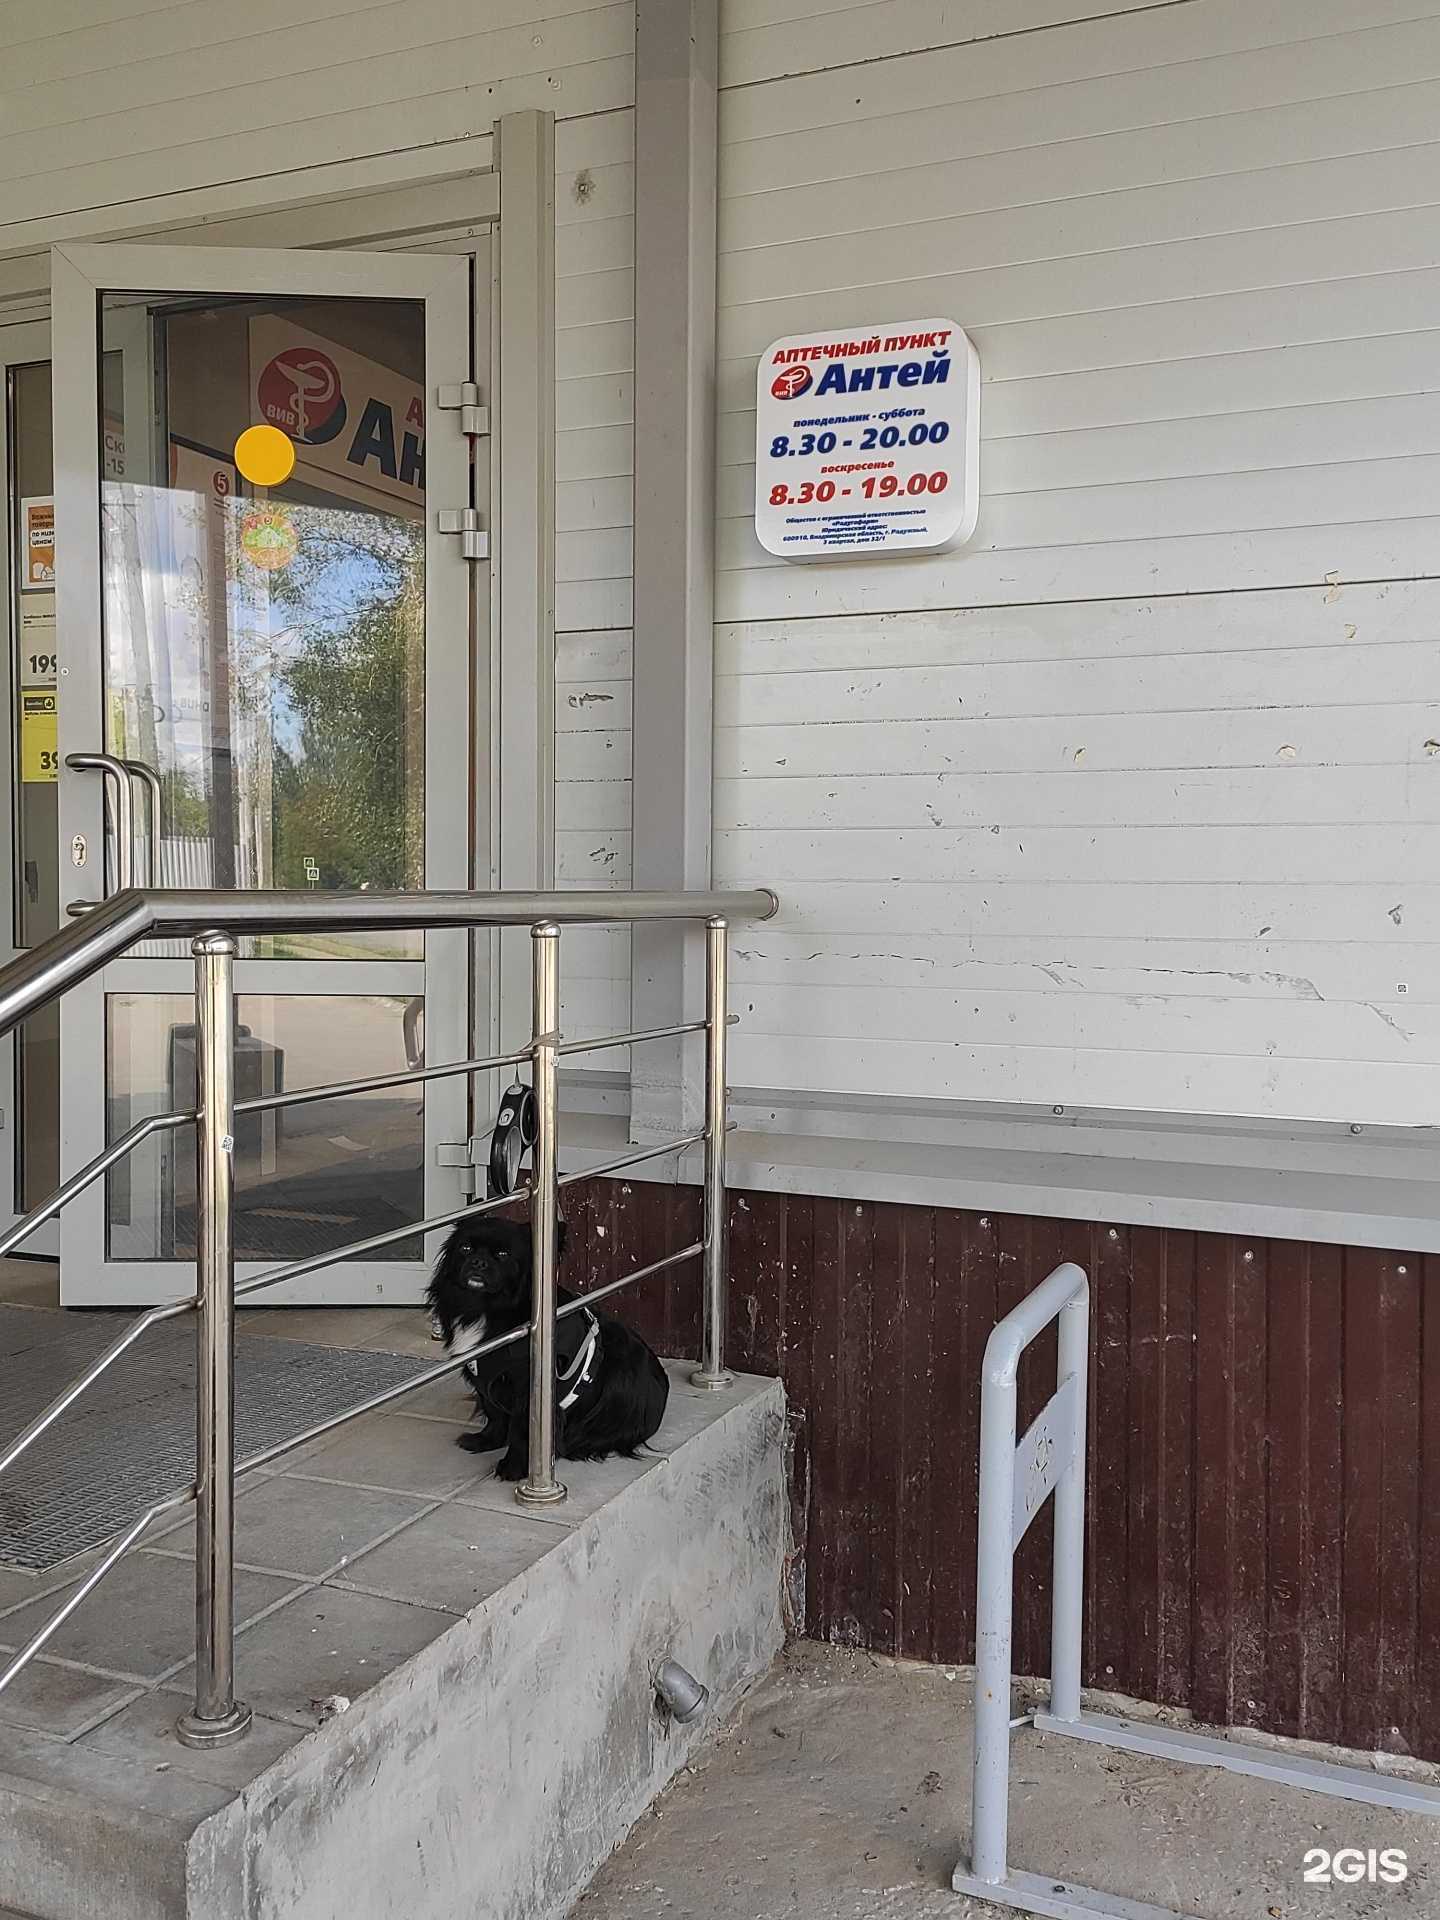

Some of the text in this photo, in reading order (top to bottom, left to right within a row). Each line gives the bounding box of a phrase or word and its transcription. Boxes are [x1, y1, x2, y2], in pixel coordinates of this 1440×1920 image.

[772, 331, 951, 364] АПТЕЧНЫЙ ПУНКТ
[814, 349, 951, 396] Антей
[266, 404, 295, 425] ВИВ
[793, 413, 871, 428] понедельник
[878, 408, 925, 421] суббота
[770, 432, 837, 458] 8.30
[859, 421, 950, 450] 20.00
[820, 460, 894, 474] воскресенье
[769, 481, 836, 506] 8.30
[861, 471, 948, 498] 19.00
[786, 516, 817, 524] Общество
[822, 512, 866, 522] ограниченной
[867, 509, 926, 518] ответственностью
